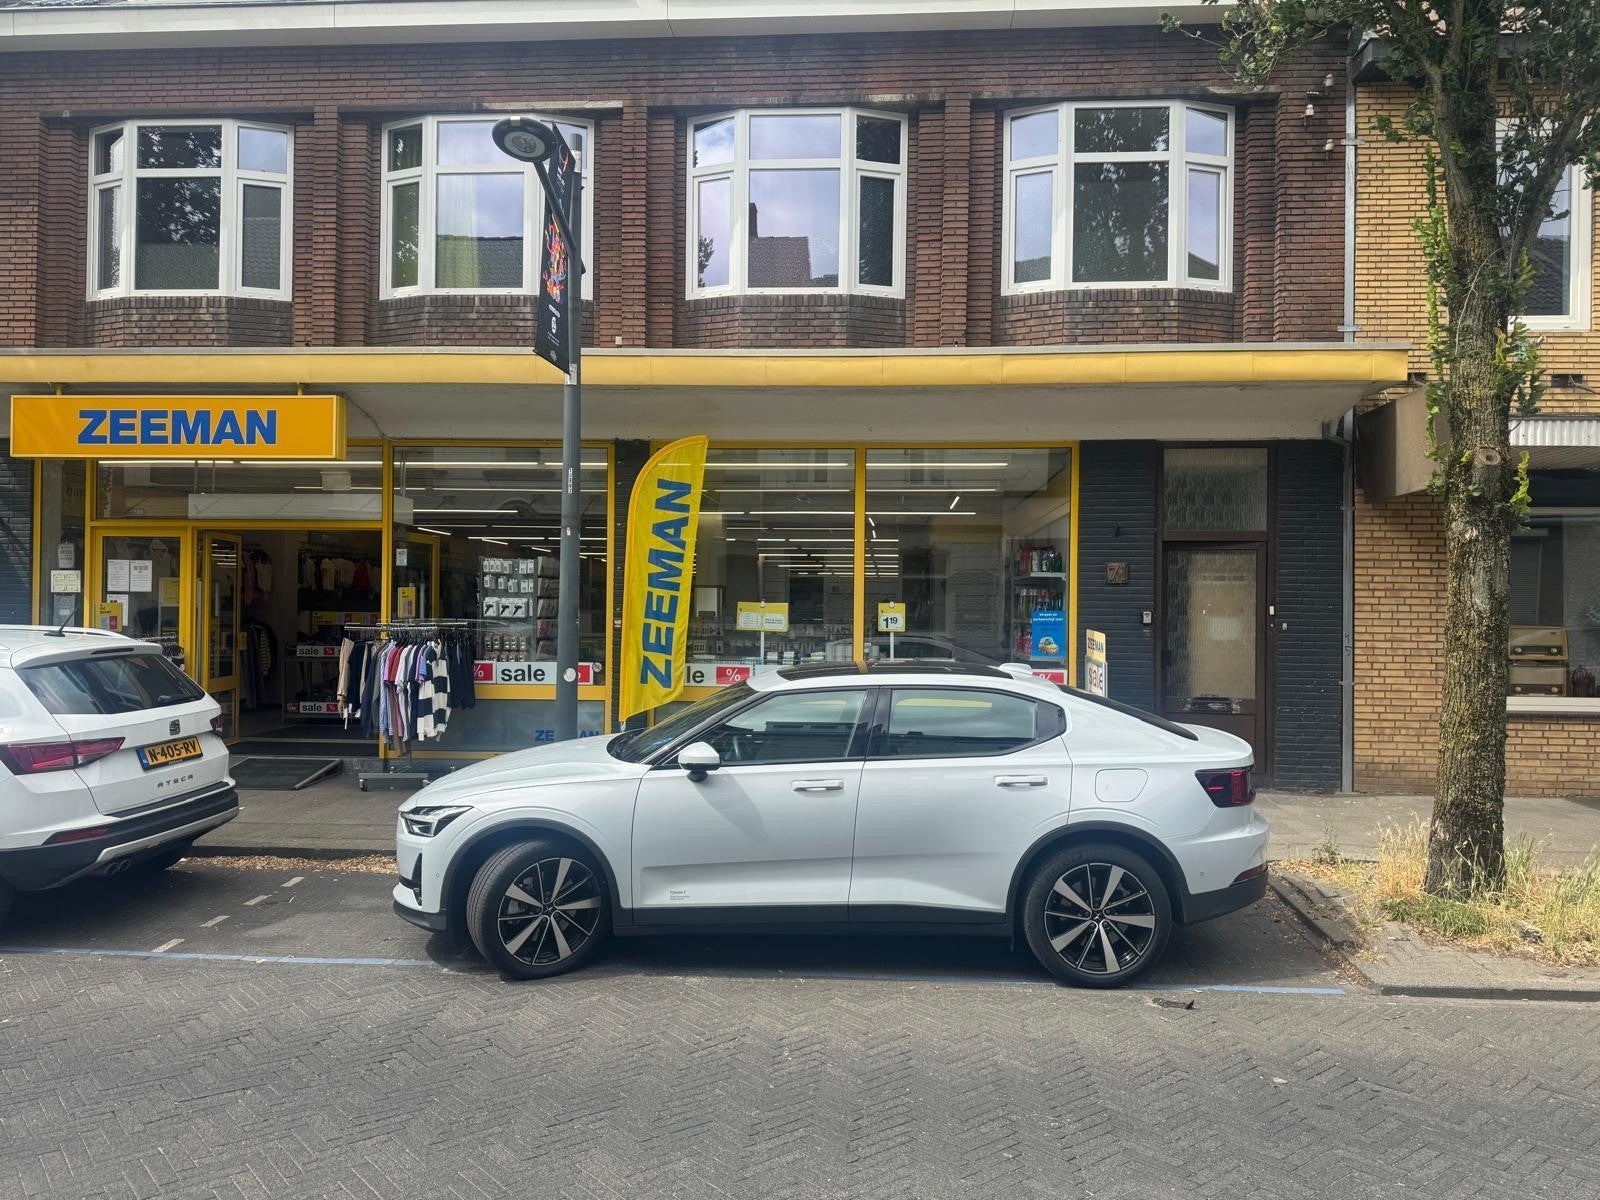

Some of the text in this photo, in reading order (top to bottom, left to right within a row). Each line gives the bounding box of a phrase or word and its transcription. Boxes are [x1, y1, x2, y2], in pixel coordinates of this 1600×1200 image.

[77, 408, 278, 446] ZEEMAN
[640, 477, 692, 689] ZEEMAN
[298, 647, 319, 656] sale
[1087, 636, 1104, 654] ZEEMAN
[500, 664, 546, 682] sale
[686, 665, 705, 684] le
[1087, 666, 1104, 691] sale
[302, 703, 322, 712] sale
[147, 740, 198, 763] N-405-RV
[157, 774, 194, 788] ATECA
